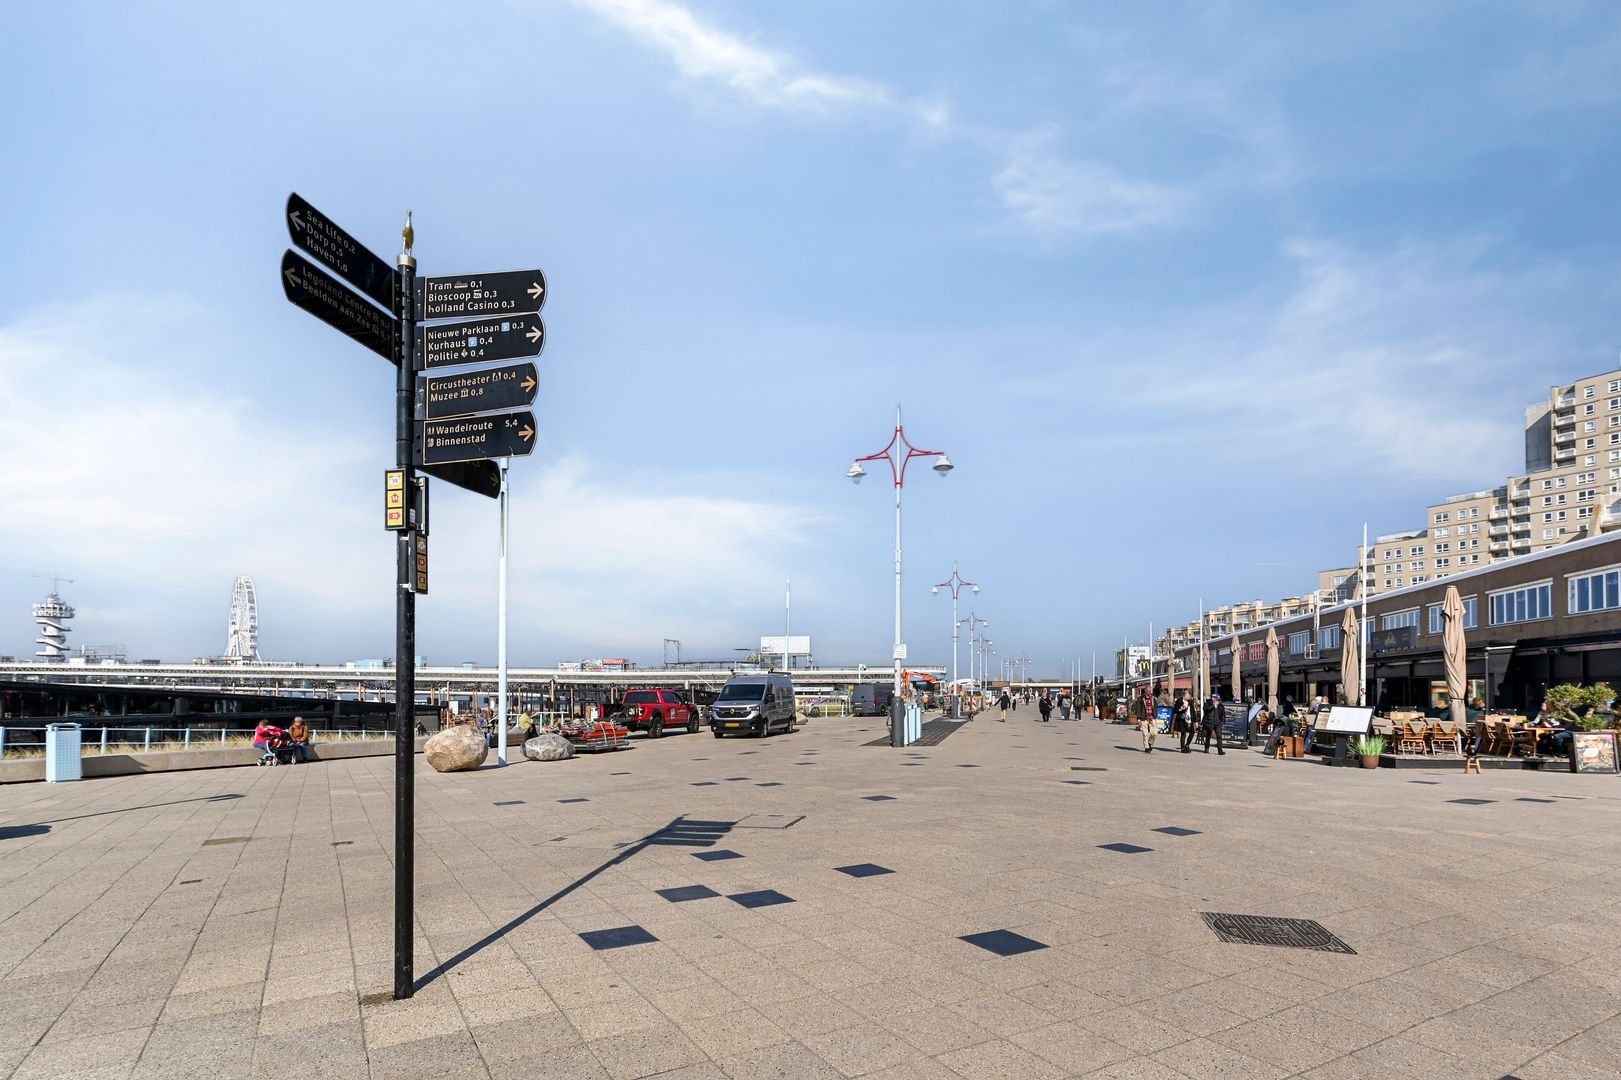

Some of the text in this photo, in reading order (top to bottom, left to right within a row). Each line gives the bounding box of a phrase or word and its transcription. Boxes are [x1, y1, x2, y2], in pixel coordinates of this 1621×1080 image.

[306, 210, 323, 229] Sea
[326, 224, 342, 244] Life
[306, 223, 329, 247] Dorp
[306, 236, 335, 263] Haven
[302, 266, 343, 298] Legoland
[428, 282, 452, 291] Tram
[302, 280, 338, 308] Beelden
[340, 305, 354, 319] aan
[357, 316, 370, 329] Zee
[428, 292, 471, 302] Bioscoop
[468, 302, 499, 311] Casino
[428, 329, 460, 340] Nieuwe
[462, 324, 500, 336] Parklaan
[428, 340, 466, 351] Kurhaus
[428, 351, 459, 362] Politie
[430, 376, 490, 391] Circustheater
[430, 391, 458, 402] Muzee
[435, 420, 493, 435] Wandelroute
[436, 434, 486, 447] Binnenstad
